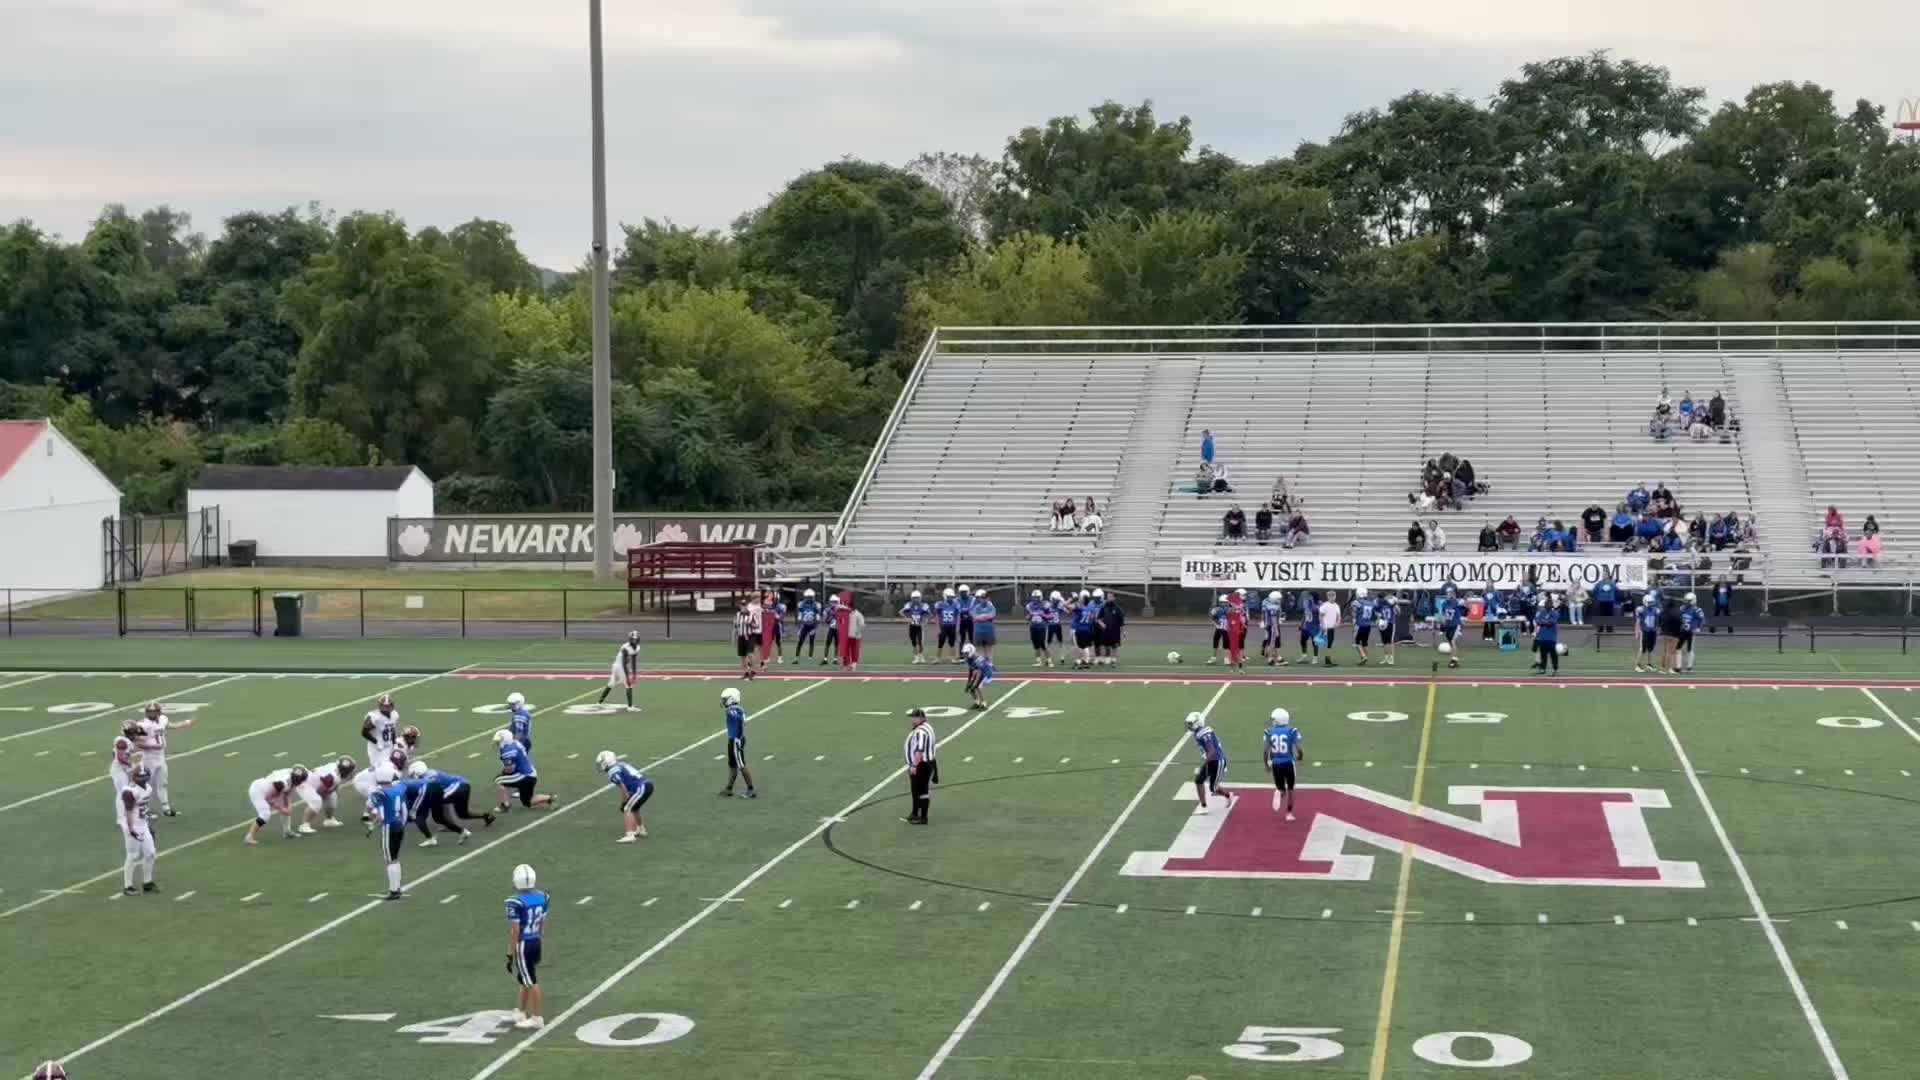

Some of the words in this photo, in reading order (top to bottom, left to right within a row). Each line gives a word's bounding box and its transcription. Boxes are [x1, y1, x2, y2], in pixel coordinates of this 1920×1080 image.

[444, 523, 595, 553] NEWARK
[699, 523, 837, 551] WILDCA
[1185, 561, 1247, 573] HUBER
[1253, 561, 1314, 581] VISIT
[1321, 561, 1621, 584] HUBERAUTOMOTIVE.COM
[1270, 733, 1289, 754] 36
[523, 905, 543, 934] 12
